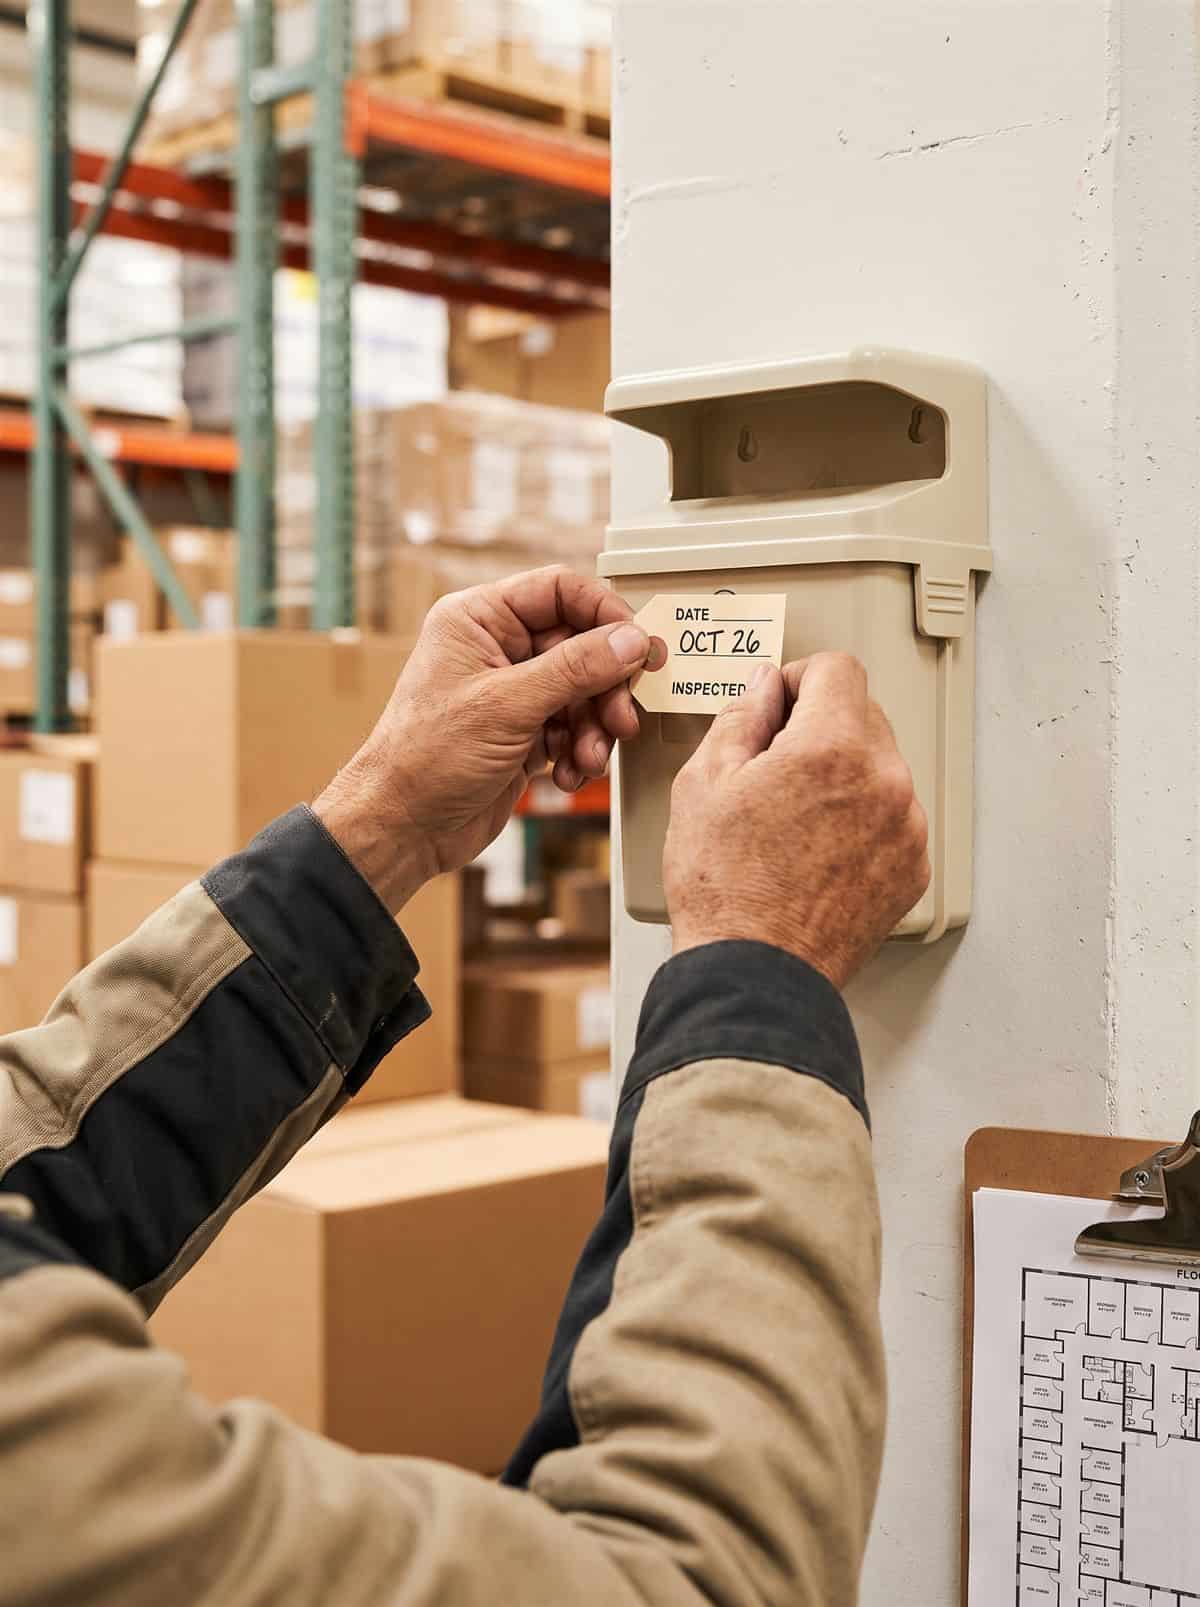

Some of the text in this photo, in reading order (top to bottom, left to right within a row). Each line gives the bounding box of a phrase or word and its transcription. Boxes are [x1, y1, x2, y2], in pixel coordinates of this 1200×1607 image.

[675, 608, 710, 621] DATE
[679, 629, 761, 654] OCT 26
[1176, 1269, 1200, 1280] FLO
